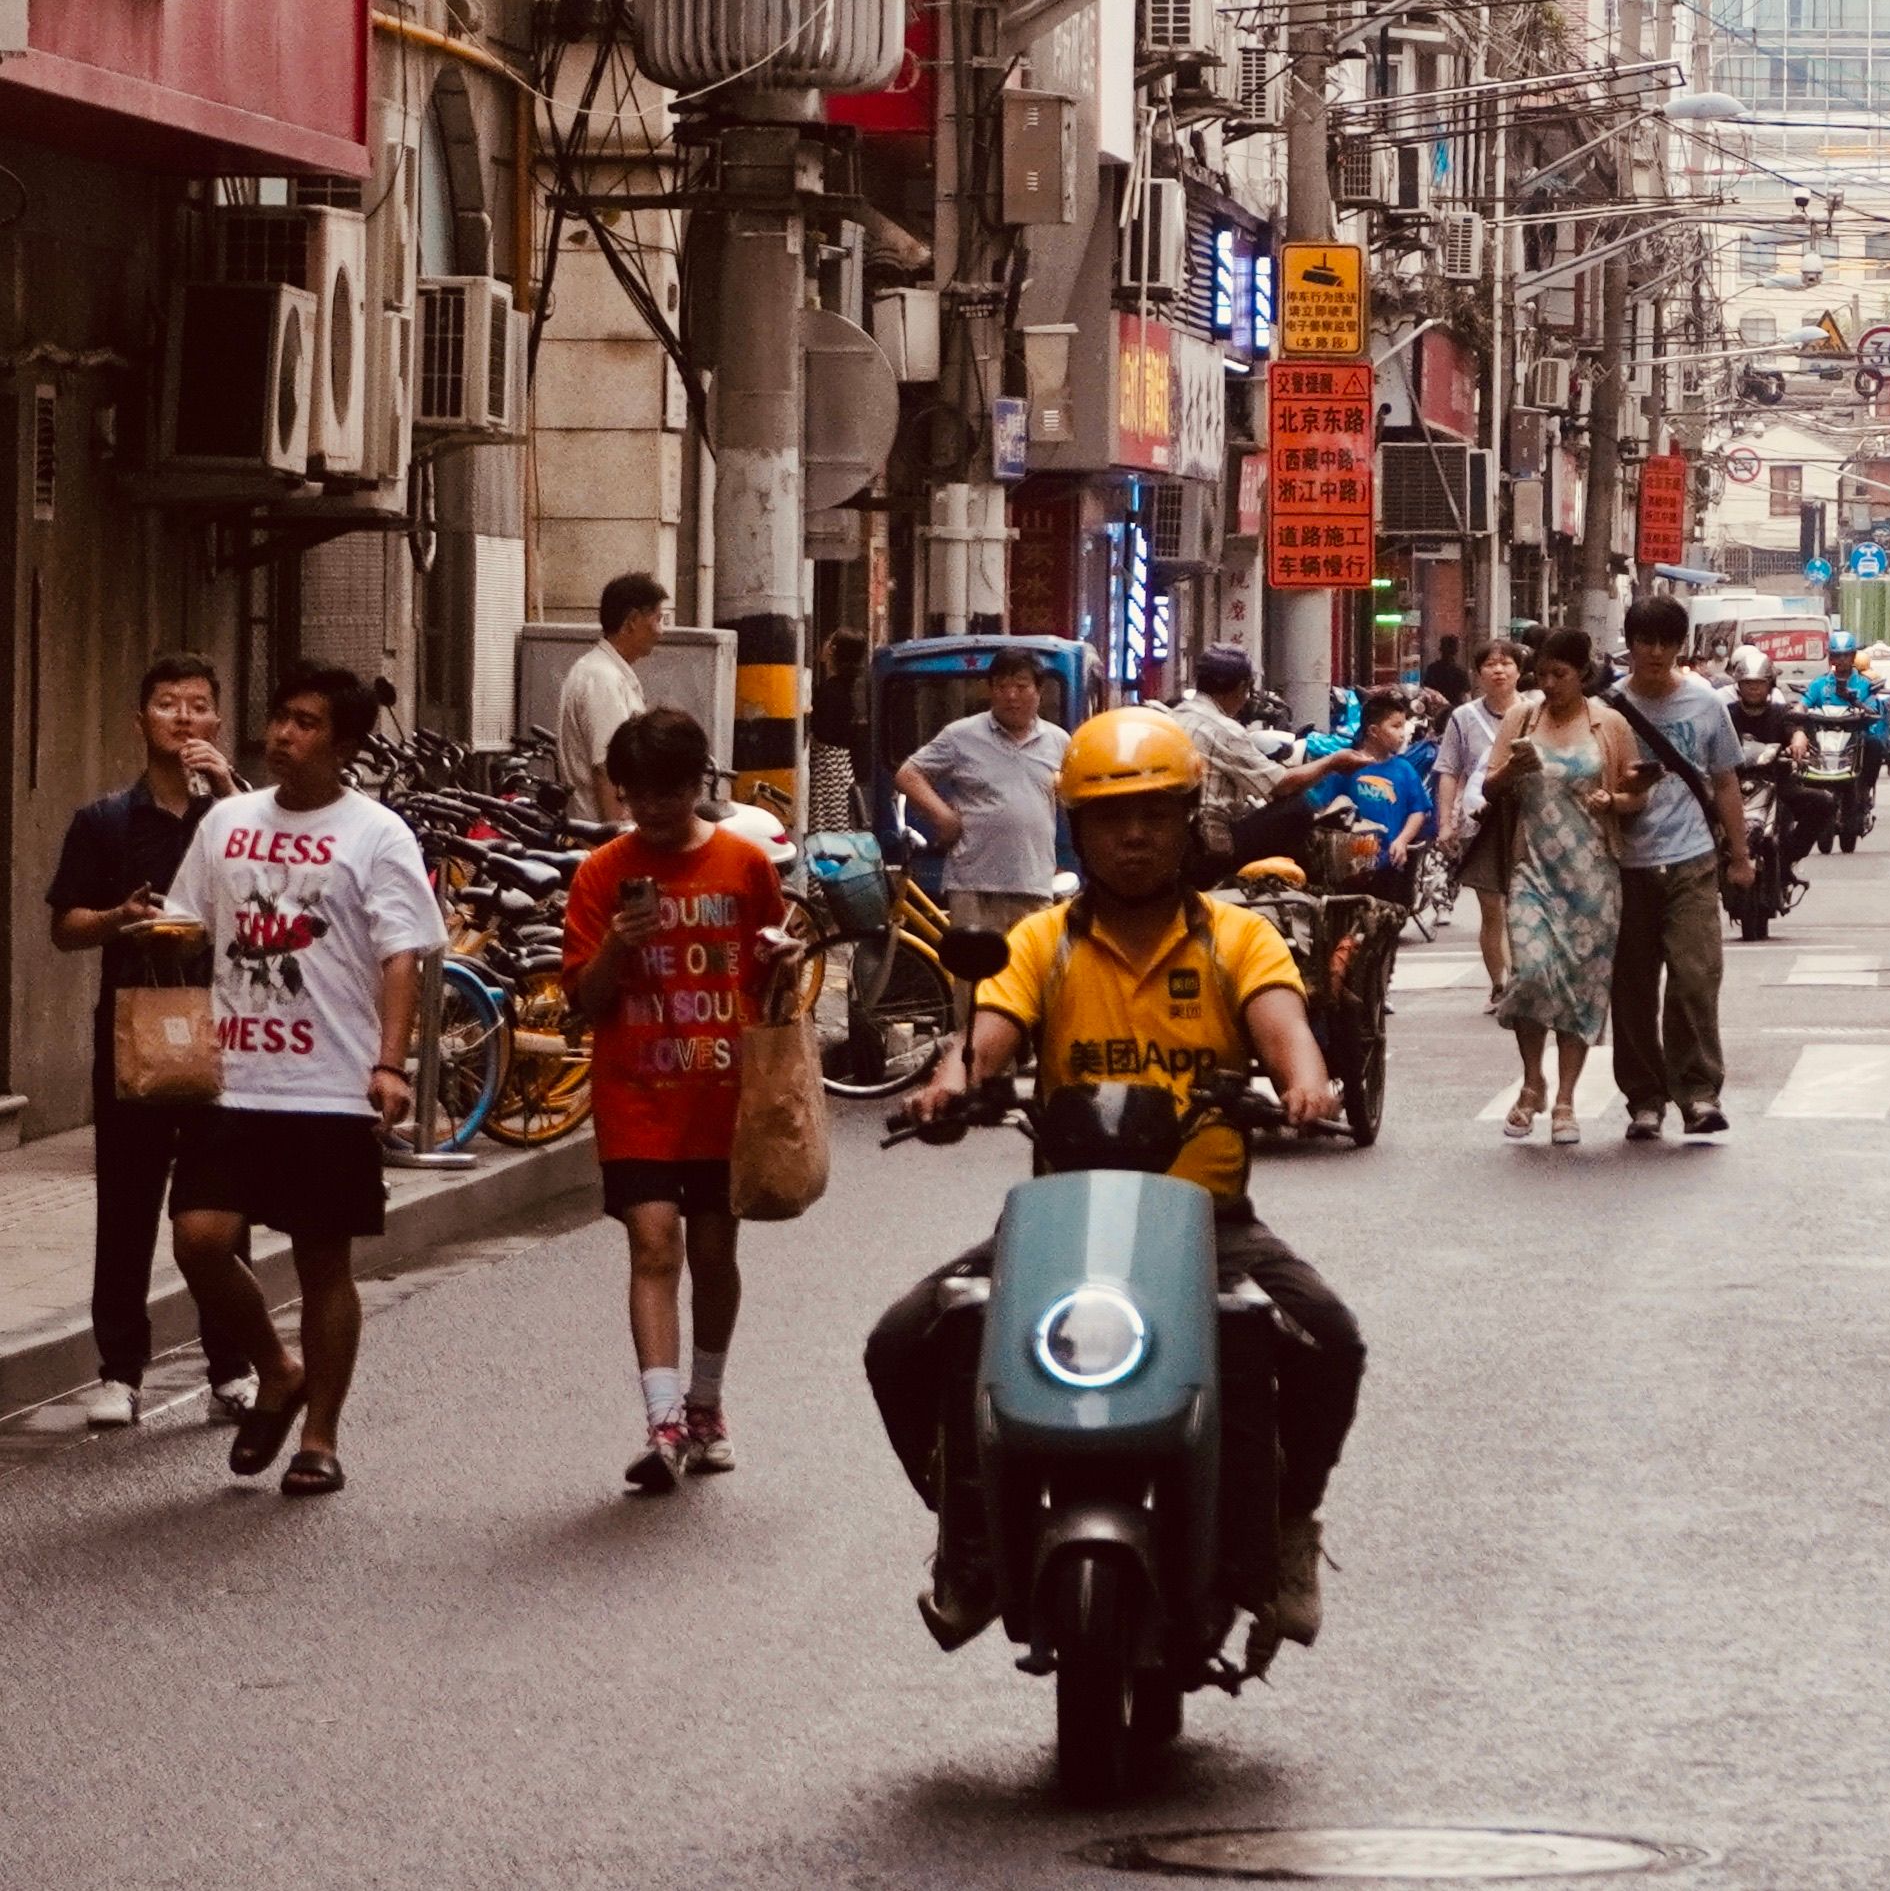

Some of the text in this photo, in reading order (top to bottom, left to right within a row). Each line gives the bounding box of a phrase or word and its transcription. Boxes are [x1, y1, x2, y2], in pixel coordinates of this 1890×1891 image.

[1278, 406, 1366, 435] 北京东路
[1278, 526, 1366, 548] 道路施工
[1278, 555, 1367, 578] 车辆慢行
[225, 828, 336, 865] BLESS
[235, 911, 314, 949] THIS
[658, 893, 740, 930] OUND
[217, 1016, 315, 1055] MESS
